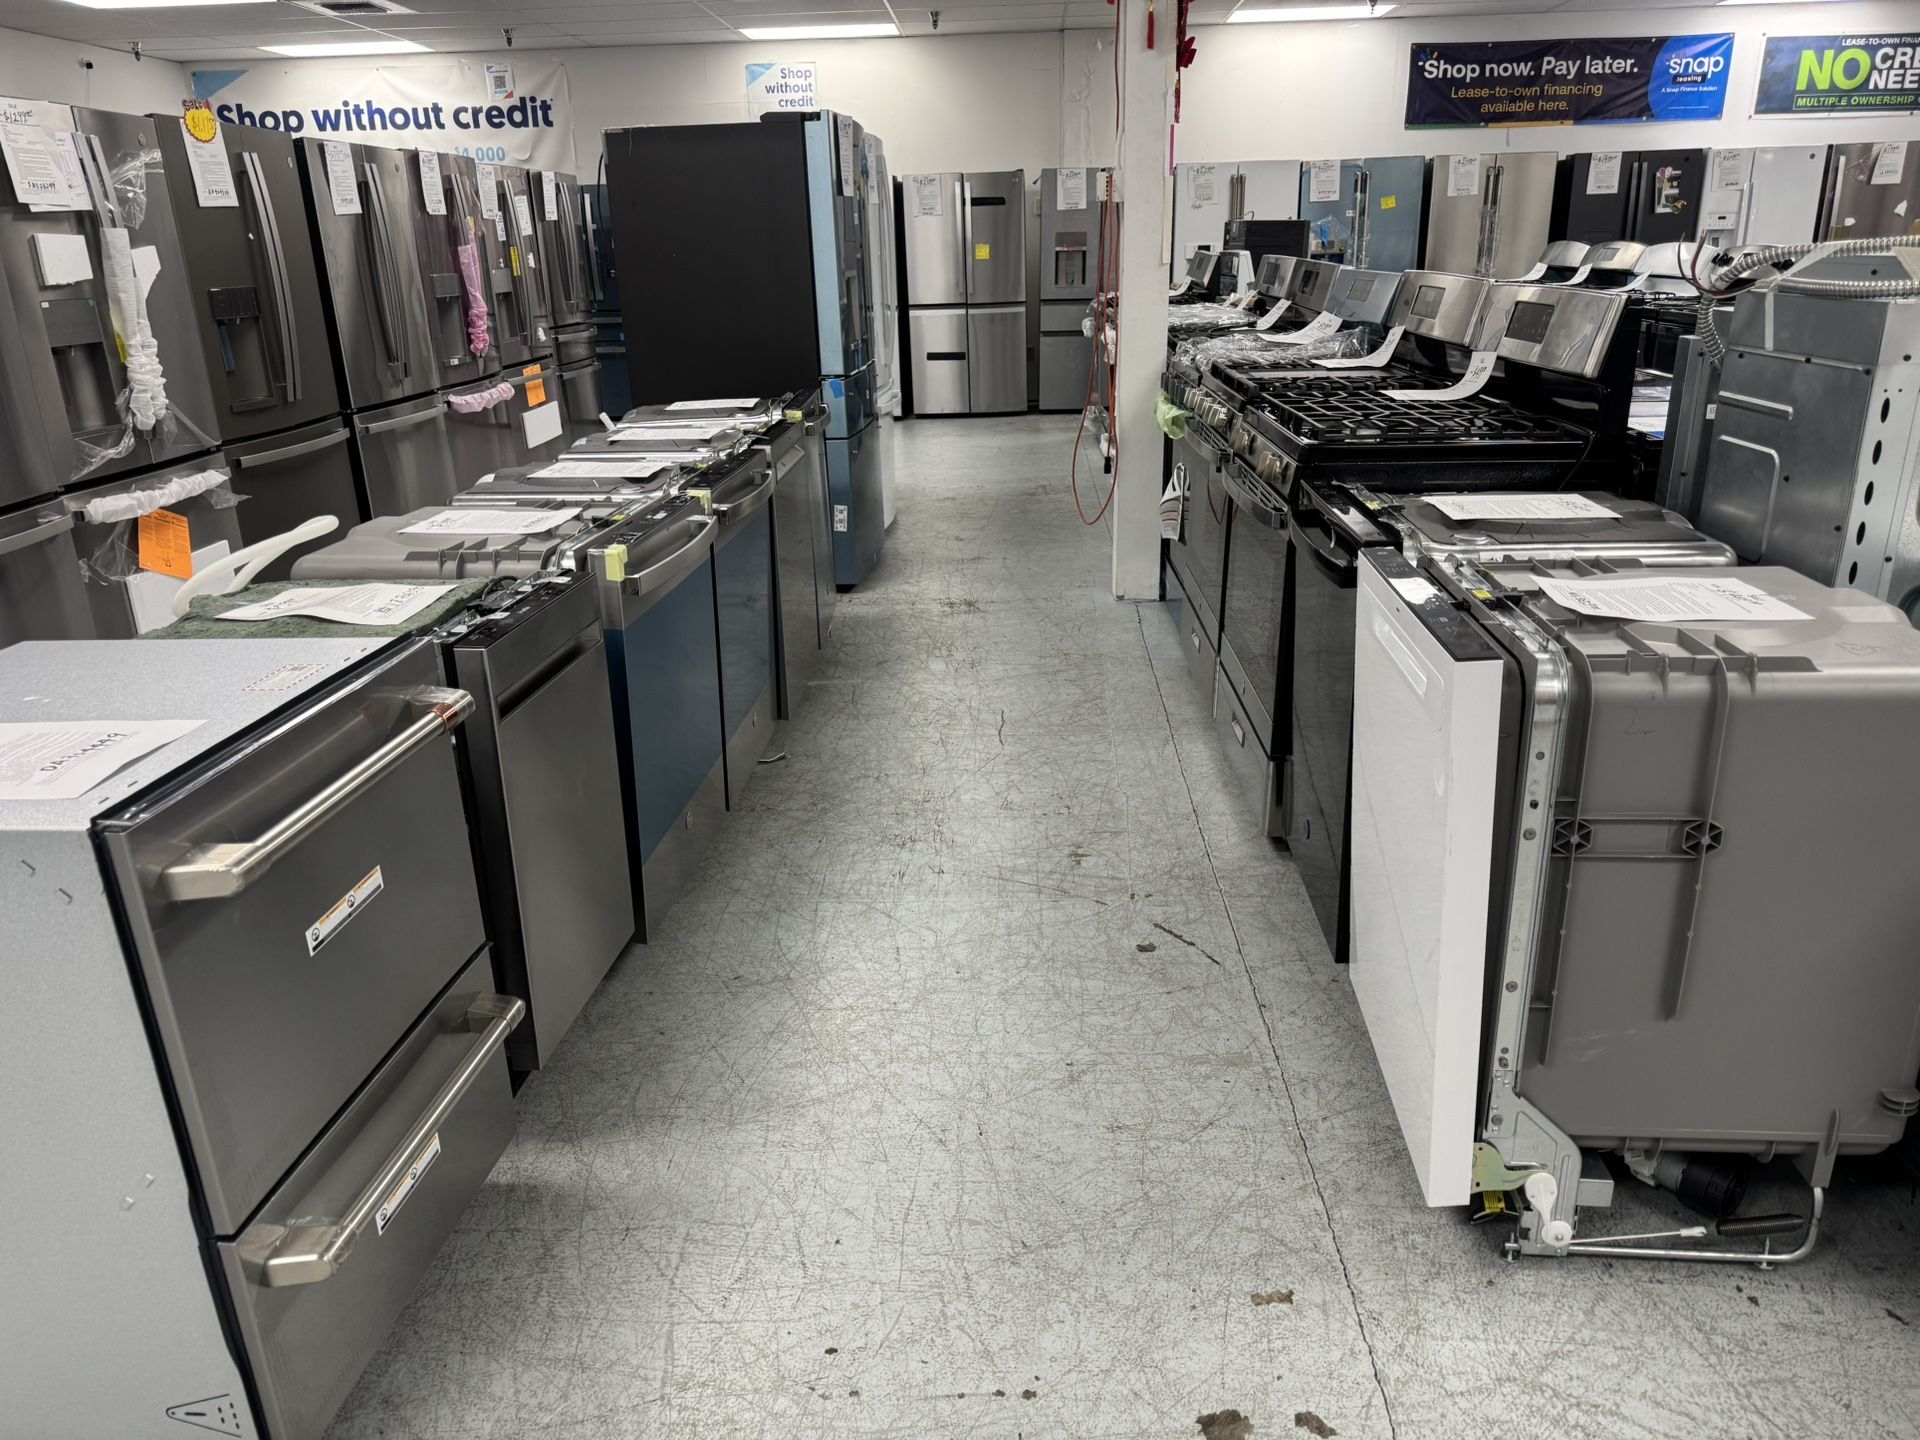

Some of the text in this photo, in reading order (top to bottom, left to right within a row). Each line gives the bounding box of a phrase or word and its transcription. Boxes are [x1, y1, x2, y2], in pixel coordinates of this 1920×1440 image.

[1842, 37, 1900, 46] LEASE-TO-OWN
[780, 67, 812, 81] Shop
[1423, 55, 1639, 82] Shop now. Pay later.
[1668, 56, 1724, 79] snap
[1796, 48, 1871, 91] NO
[1676, 75, 1702, 83] leasing
[765, 81, 814, 94] without
[1451, 81, 1604, 99] Lease-to-own financing
[778, 96, 814, 107] credit
[1481, 98, 1571, 114] available here.
[1796, 95, 1915, 107] MULTIPLE OWNERSHIP
[216, 103, 304, 134] Shop
[311, 100, 445, 132] without
[454, 145, 506, 162] $4000
